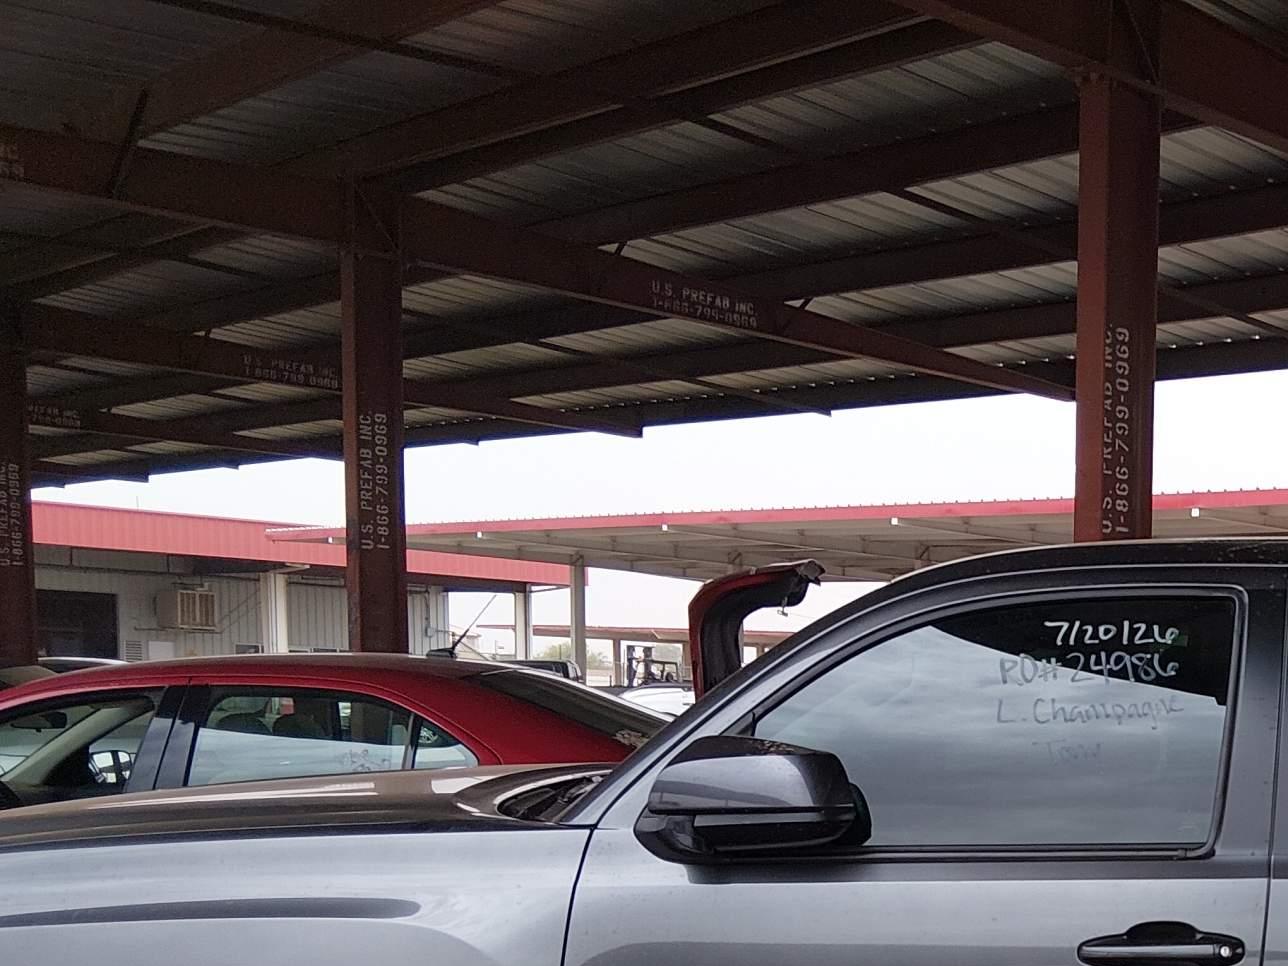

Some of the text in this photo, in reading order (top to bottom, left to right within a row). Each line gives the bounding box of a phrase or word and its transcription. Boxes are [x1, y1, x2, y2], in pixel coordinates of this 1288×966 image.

[681, 287, 730, 310] PREFAB
[358, 410, 374, 550] U.S. PREFAB INC.
[374, 413, 391, 550] 1-866-799-0969
[1115, 327, 1130, 533] 1-866-799-0969
[1043, 620, 1180, 646] 7/20/26
